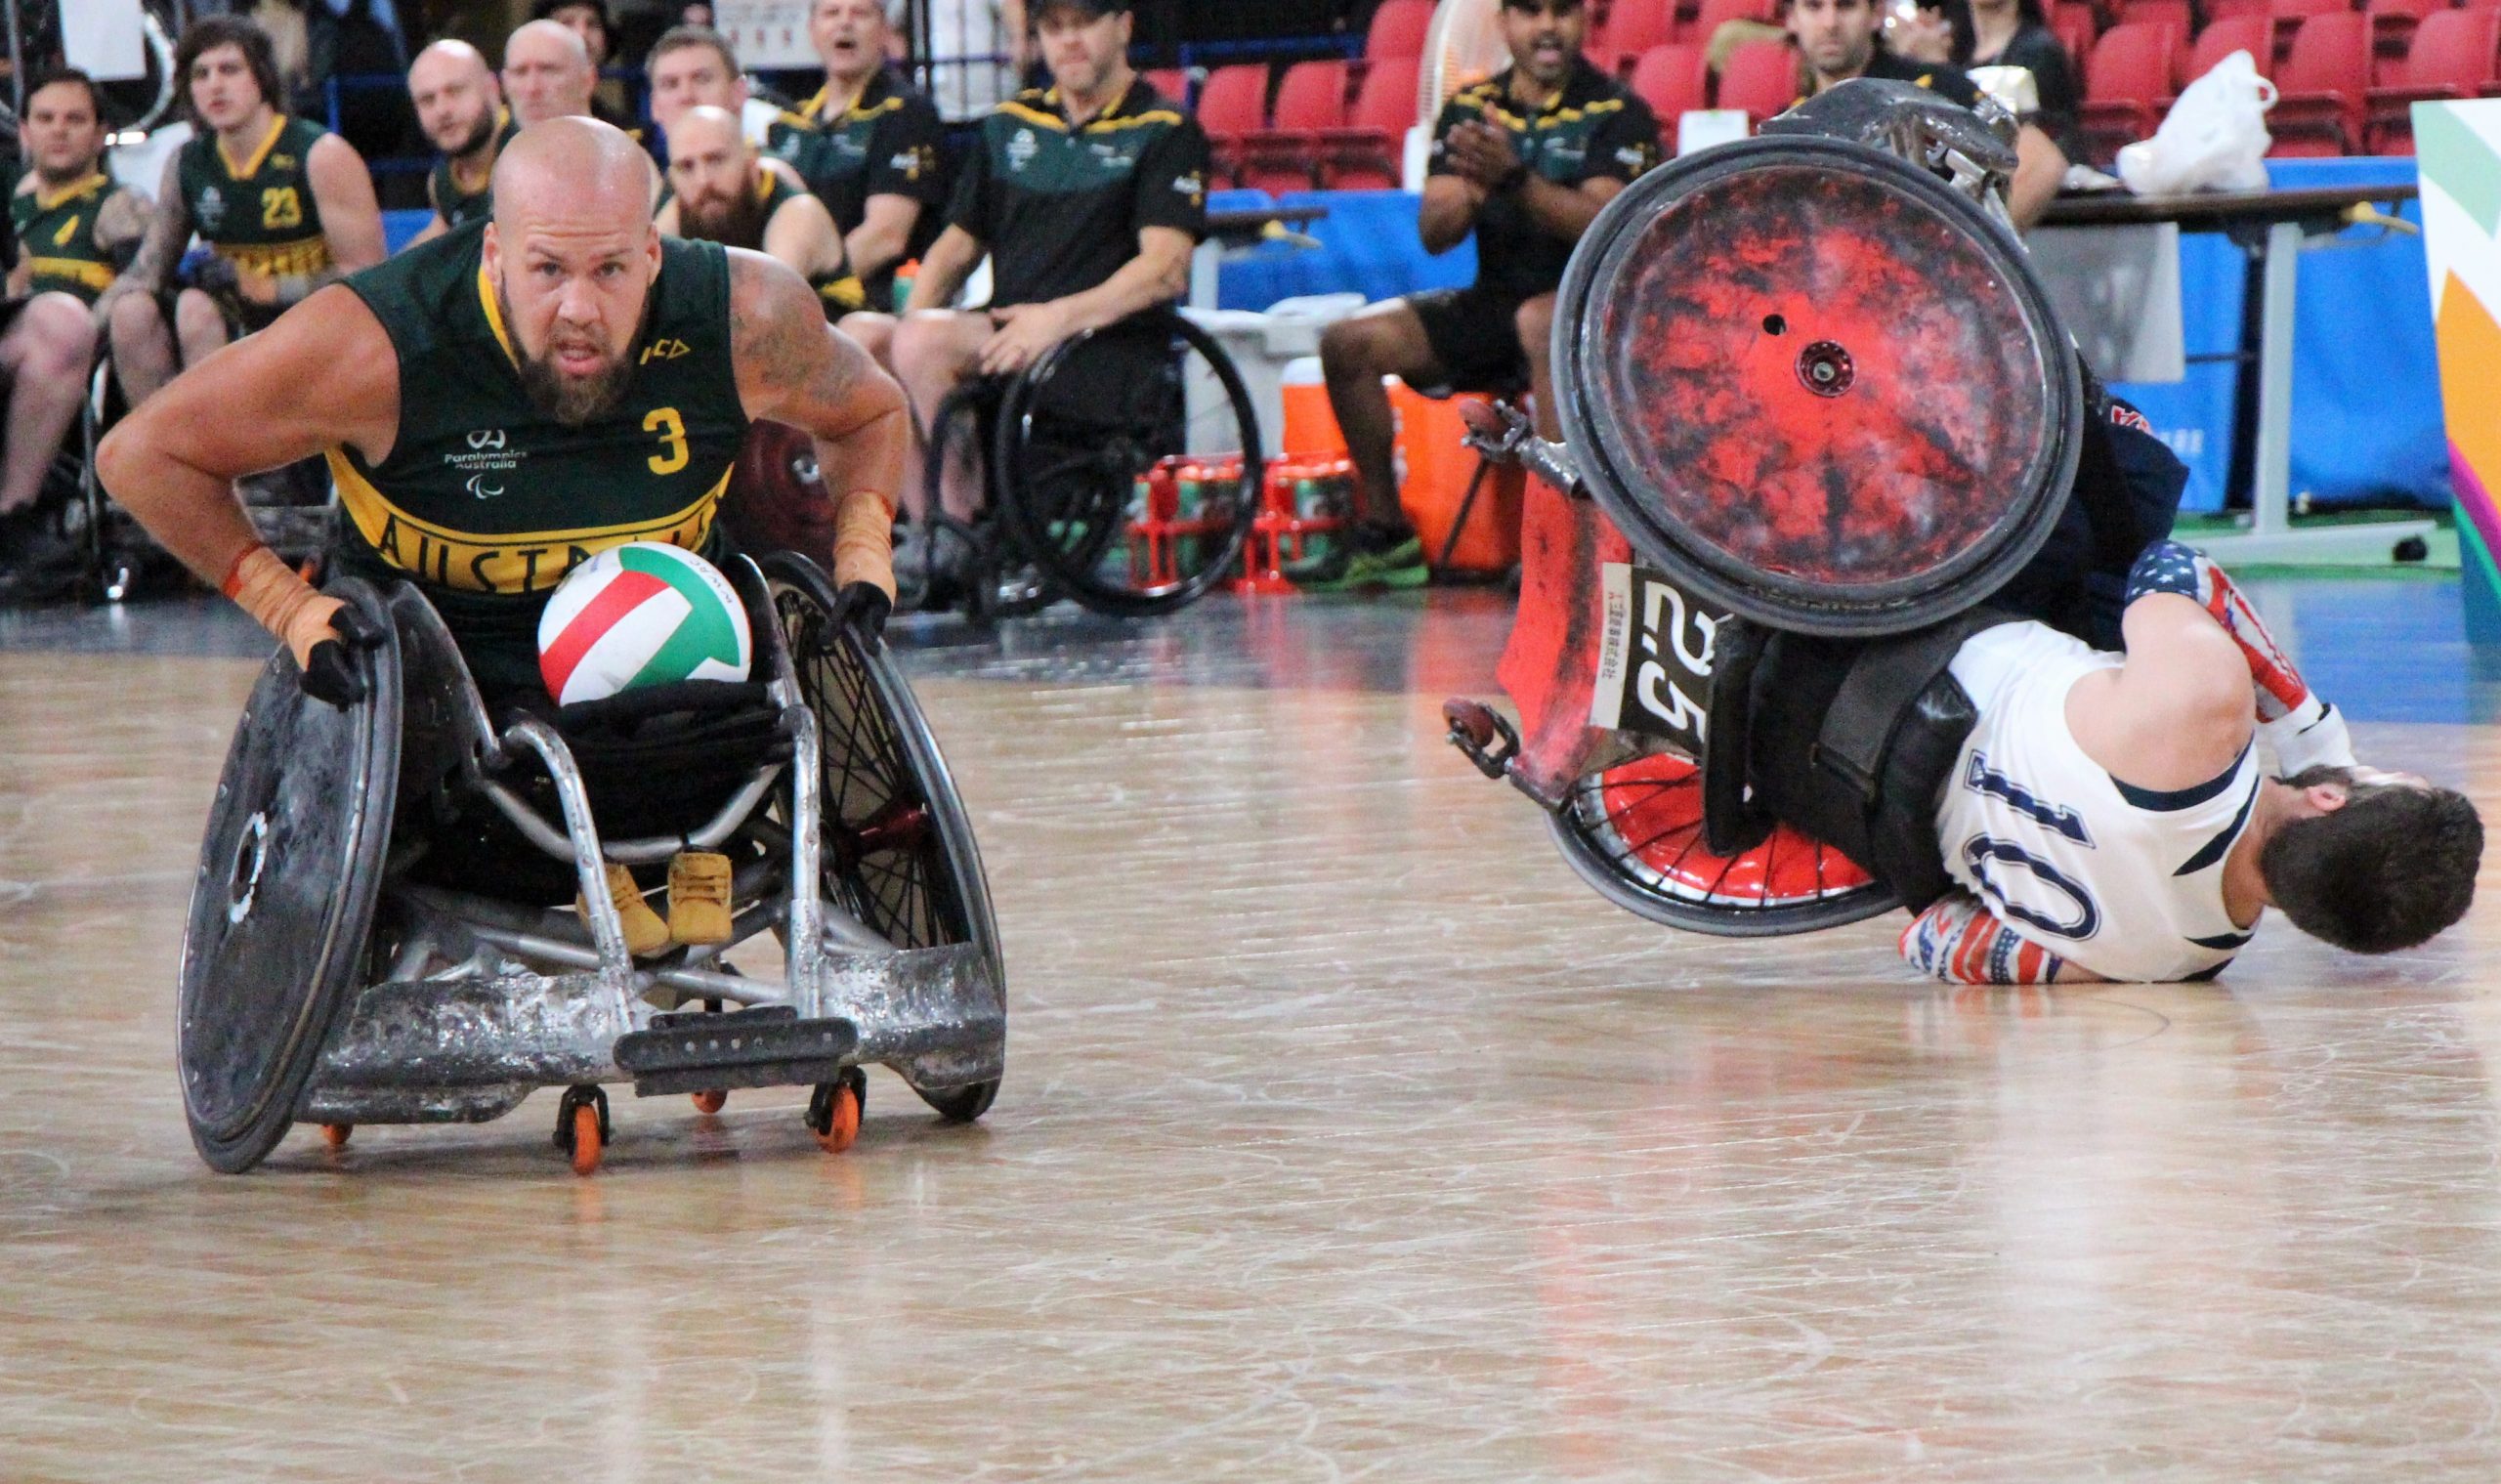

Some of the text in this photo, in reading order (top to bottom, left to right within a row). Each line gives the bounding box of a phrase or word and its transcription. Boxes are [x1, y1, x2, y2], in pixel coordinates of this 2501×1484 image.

[262, 187, 302, 230] 23
[445, 449, 528, 464] Paralympics
[454, 460, 517, 469] Australia
[642, 406, 690, 476] 3
[1636, 580, 1717, 743] 2.5
[1964, 748, 2101, 942] 10
